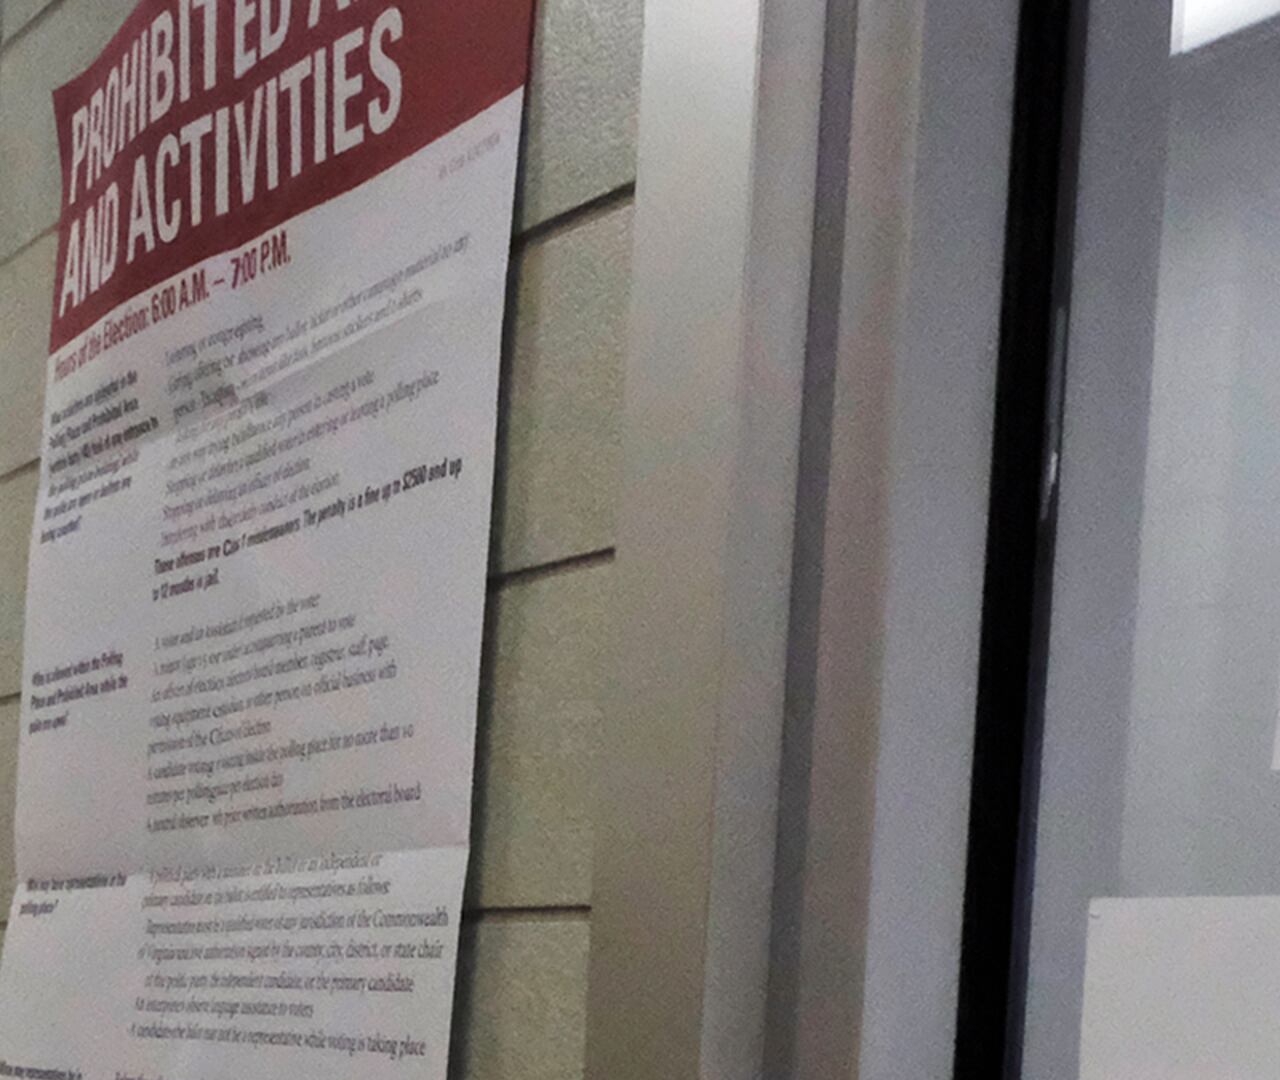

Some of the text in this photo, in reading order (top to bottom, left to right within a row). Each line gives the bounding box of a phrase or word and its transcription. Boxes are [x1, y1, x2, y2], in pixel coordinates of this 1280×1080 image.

[58, 7, 404, 318] AND ACTIVITIES
[103, 304, 150, 351] Election:
[151, 284, 177, 324] 6:00
[178, 268, 210, 311] A.M.
[230, 248, 257, 290] 7:00
[260, 228, 292, 274] P.M.
